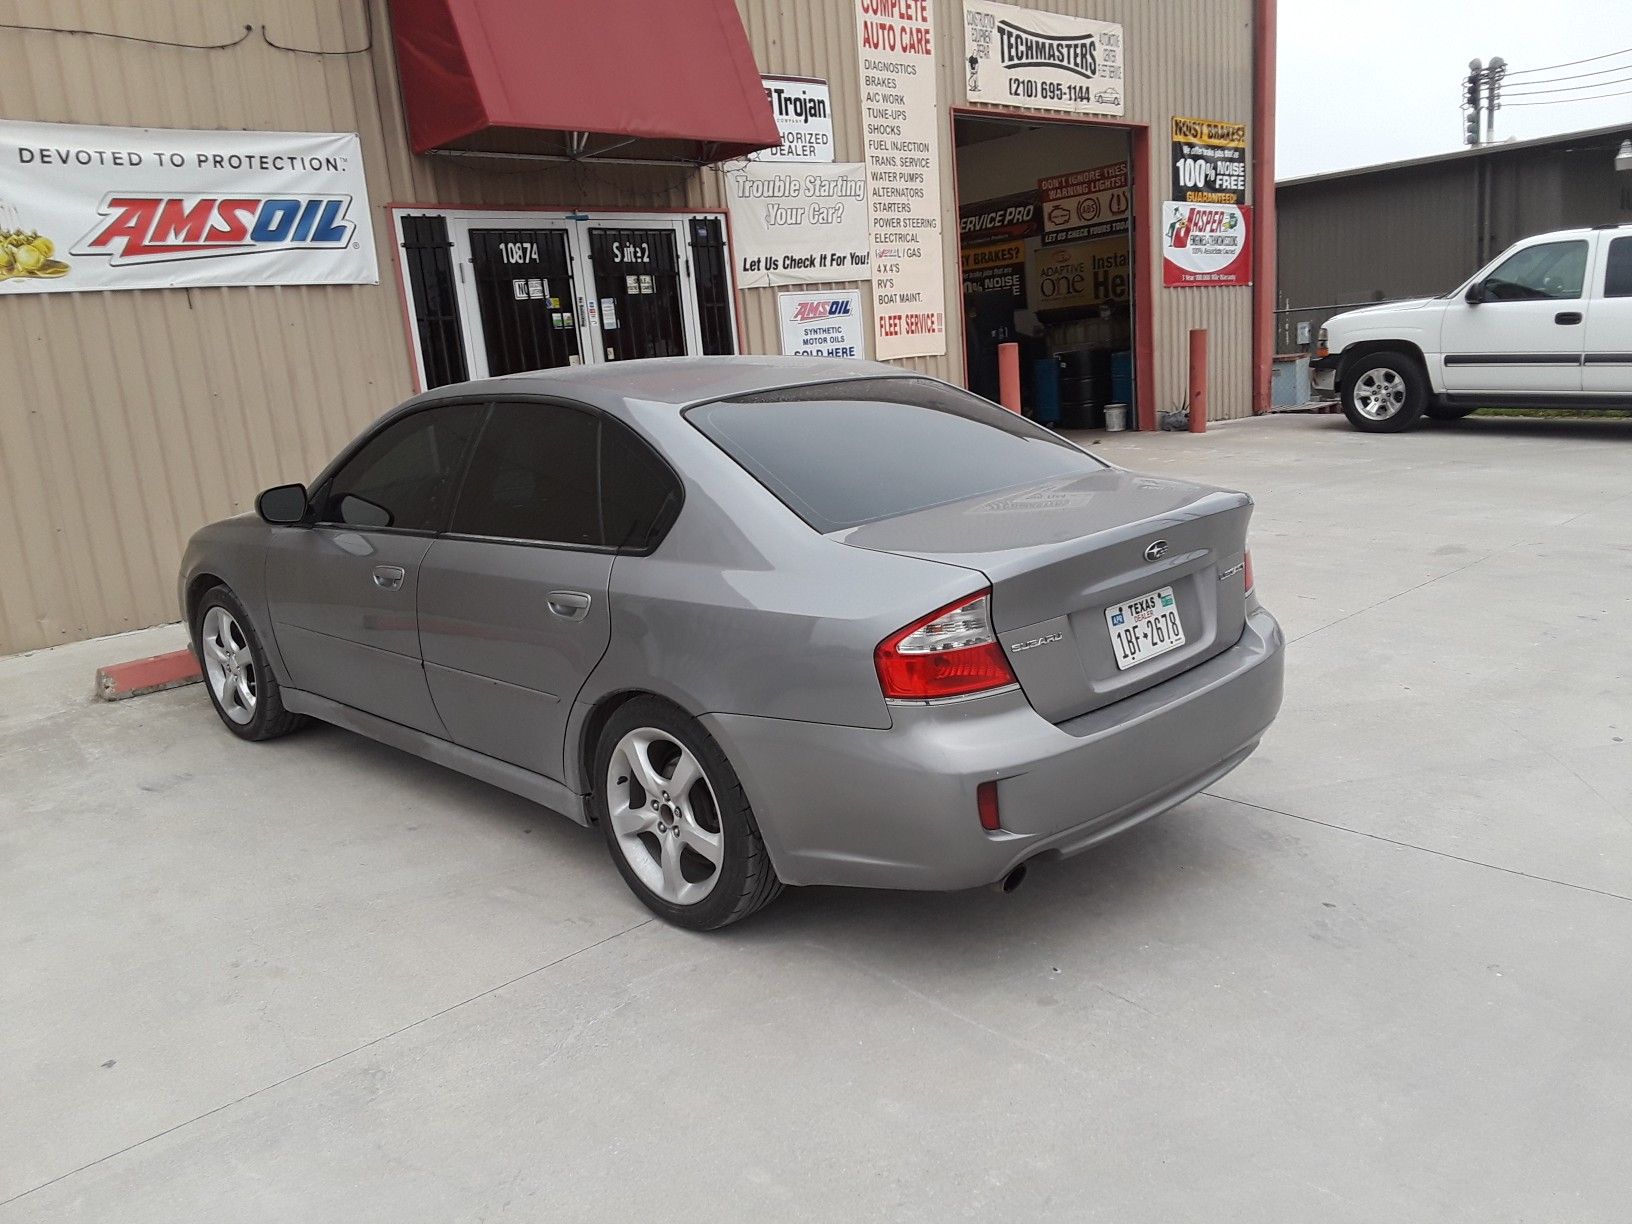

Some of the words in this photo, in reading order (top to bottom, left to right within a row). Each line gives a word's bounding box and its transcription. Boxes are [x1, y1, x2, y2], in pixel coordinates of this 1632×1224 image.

[863, 20, 896, 52] AUTO
[900, 25, 931, 55] CARE
[997, 26, 1097, 76] TECHMASTERS
[864, 59, 917, 75] DIAGNOSTICS
[865, 75, 897, 89] BRAKES
[866, 91, 880, 103] A/C
[881, 93, 905, 105] WORK
[1009, 78, 1037, 97] (210)
[1041, 82, 1091, 103] 695-1144
[774, 88, 827, 124] Trojan
[867, 107, 907, 121] TUNE-UPS
[867, 123, 901, 136] SHOCKS
[770, 145, 816, 157] DEALER
[868, 140, 889, 151] FUEL
[890, 141, 930, 153] INJECTION
[18, 147, 142, 166] DEVOTED
[154, 152, 186, 168] TO
[870, 155, 898, 167] TRANS.
[899, 157, 931, 169] SERVICE
[870, 171, 898, 182] WATER
[899, 172, 924, 184] PUMPS
[1068, 170, 1101, 185] IGNORE
[1104, 163, 1127, 177] THES
[1176, 158, 1216, 188] 100%
[1217, 161, 1244, 176] NOISE
[736, 175, 800, 198] Trouble
[803, 175, 865, 201] Starting
[1215, 175, 1244, 190] FREE
[872, 187, 924, 199] ALTERNATORS
[1049, 184, 1089, 200] WARNING
[767, 203, 805, 225] Your
[808, 202, 844, 224] Car?
[873, 202, 912, 213] STARTERS
[87, 198, 351, 257] AMSOIL
[874, 217, 902, 229] POWER
[903, 218, 937, 229] STEERING
[960, 211, 1004, 233] ERVICE
[1173, 207, 1226, 249] JASPER
[875, 233, 919, 243] ELECTRICAL
[500, 242, 539, 263] 10874
[642, 242, 650, 262] 2
[907, 248, 922, 258] GAS
[973, 247, 1020, 265] BRAKES?
[743, 257, 761, 272] Let
[765, 256, 779, 271] Us
[782, 254, 816, 270] Check
[820, 254, 828, 267] It
[830, 252, 847, 267] For
[849, 251, 870, 266] You!
[1040, 262, 1085, 277] ADAPTIVE
[878, 279, 894, 289] RV'S
[984, 275, 1020, 290] NOISE
[1040, 273, 1085, 298] one
[879, 294, 898, 305] BOAT
[899, 293, 923, 303] MAINT.
[793, 300, 850, 321] AMSOIL
[804, 327, 842, 336] SYNTHETIC
[880, 315, 902, 337] FLEET
[905, 313, 936, 335] SERVICE
[803, 336, 828, 345] MOTOR
[827, 347, 855, 358] HERE
[1128, 597, 1156, 616] TEXAS
[1134, 610, 1154, 623] DEALER
[1147, 611, 1180, 647] 2678
[1011, 632, 1063, 652] SUBARU
